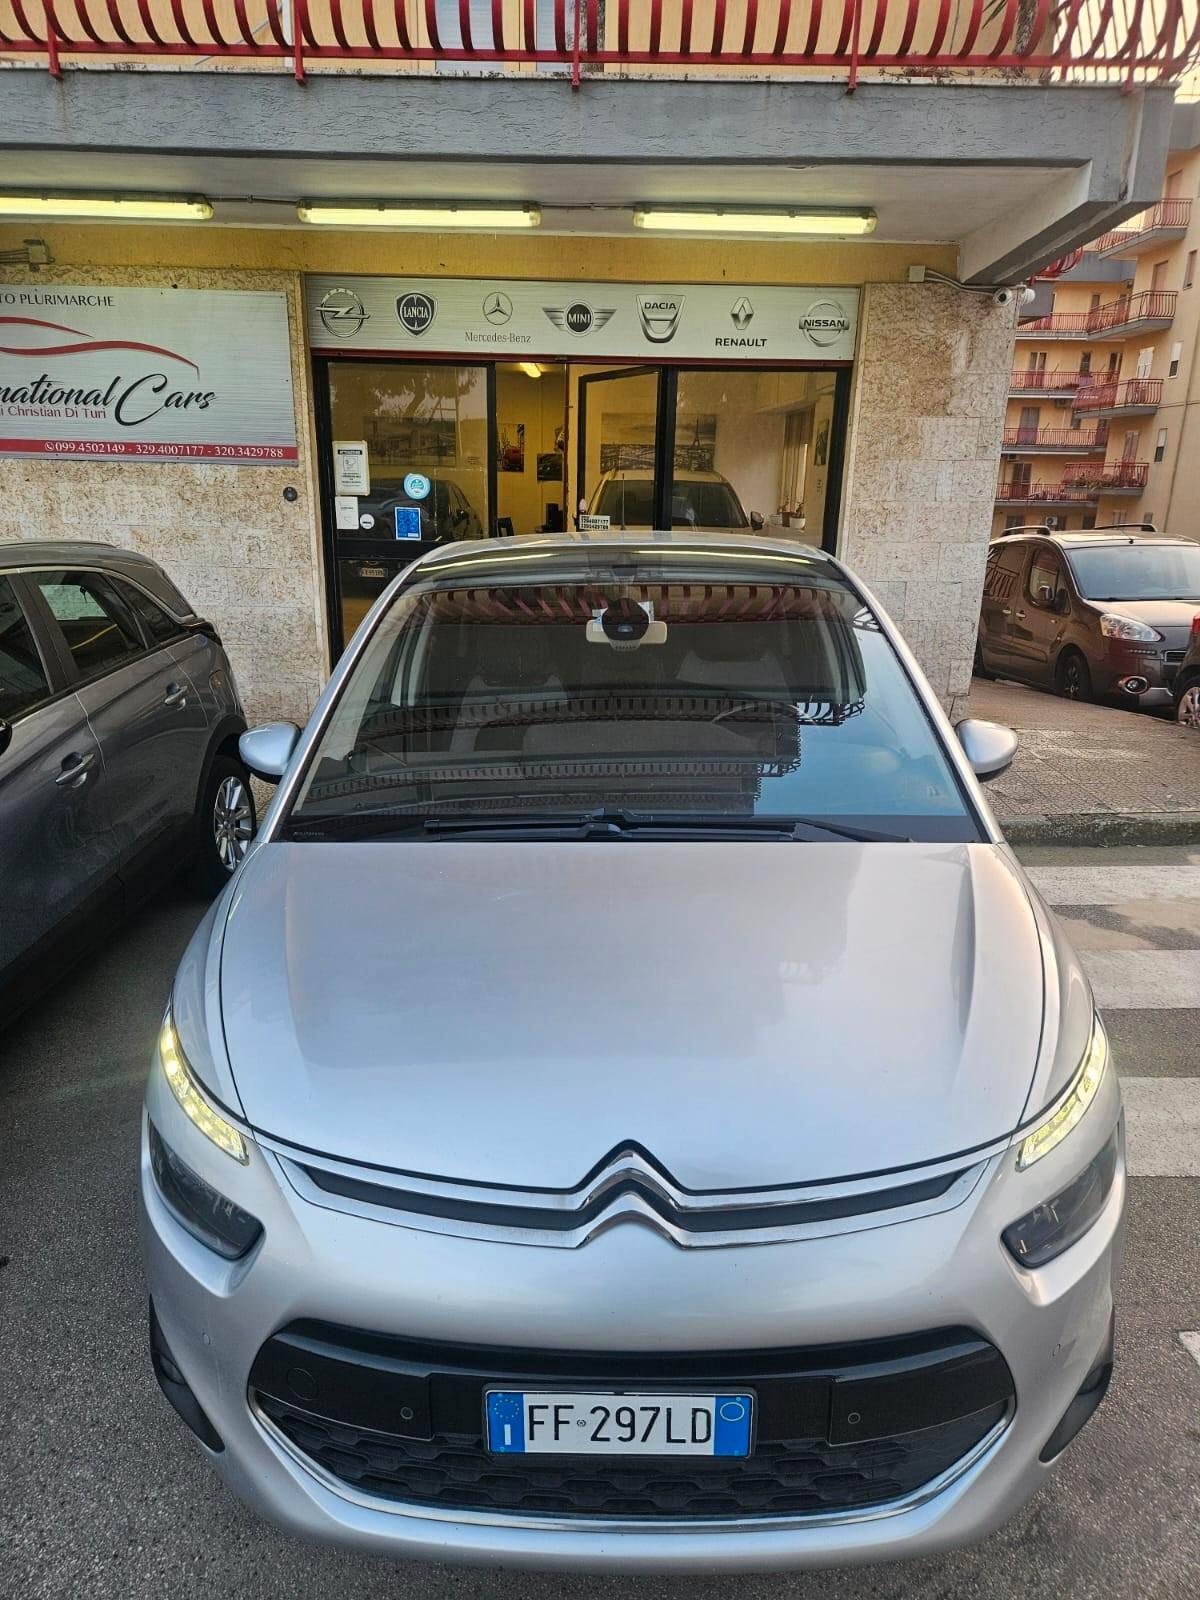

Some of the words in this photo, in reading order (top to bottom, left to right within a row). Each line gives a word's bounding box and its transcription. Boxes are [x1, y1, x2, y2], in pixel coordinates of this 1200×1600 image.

[20, 293, 115, 307] PLURIMARCHE
[644, 301, 677, 310] DACIA
[403, 306, 429, 319] LANCIA
[567, 312, 591, 324] MINI
[803, 319, 845, 329] NISSAN
[464, 331, 532, 344] Mercedes-Benz
[714, 337, 768, 347] RENAULT
[114, 373, 216, 426] Cars
[8, 405, 61, 418] Christian
[65, 405, 79, 418] Di
[83, 406, 107, 419] Turi
[54, 441, 125, 453] 099.4502149
[215, 446, 284, 458] 320.3429788
[528, 1404, 574, 1440] FF
[590, 1406, 712, 1444] 297LD
